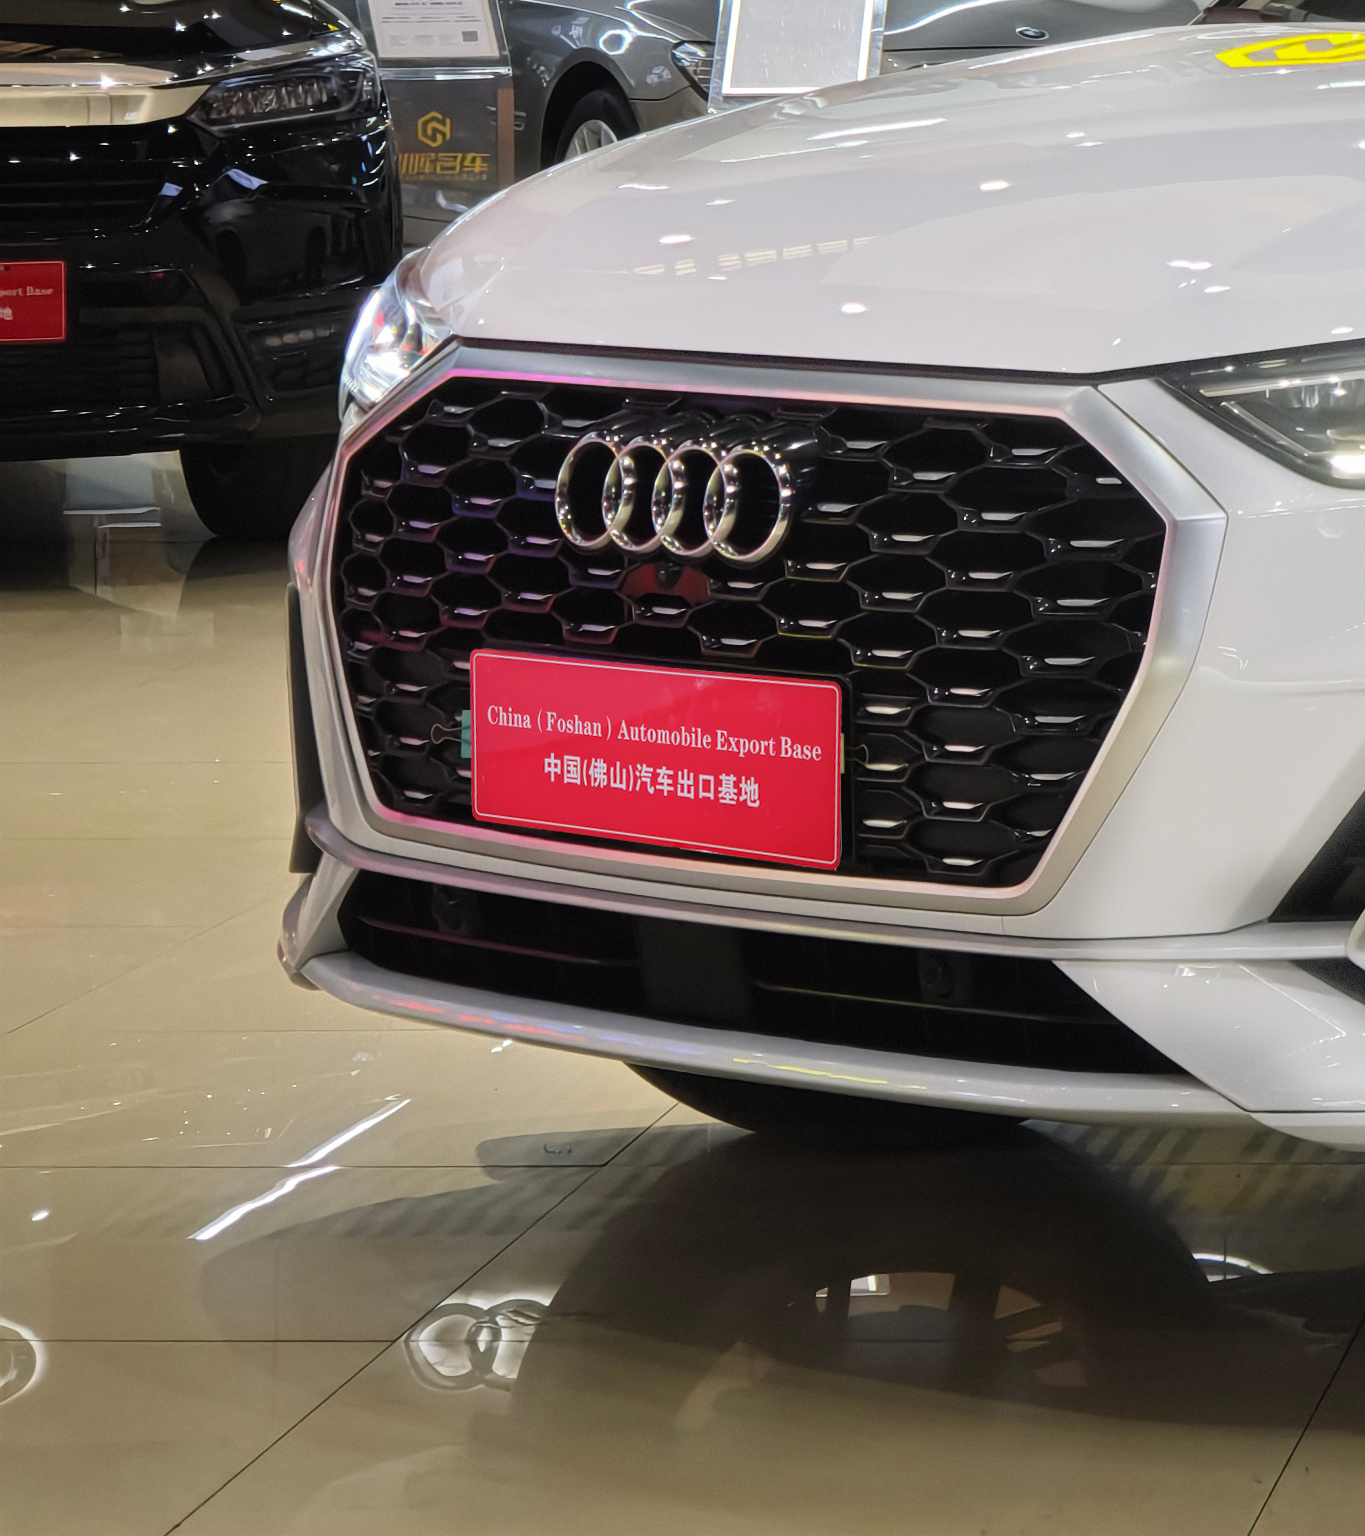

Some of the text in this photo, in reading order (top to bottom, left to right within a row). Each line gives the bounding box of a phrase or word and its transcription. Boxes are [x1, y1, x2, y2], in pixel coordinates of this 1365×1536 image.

[487, 705, 532, 730] China
[617, 722, 712, 750] Automobile
[715, 730, 777, 758] Export
[780, 737, 823, 762] Base
[543, 752, 761, 809] 中国(佛山)汽车出口基地
